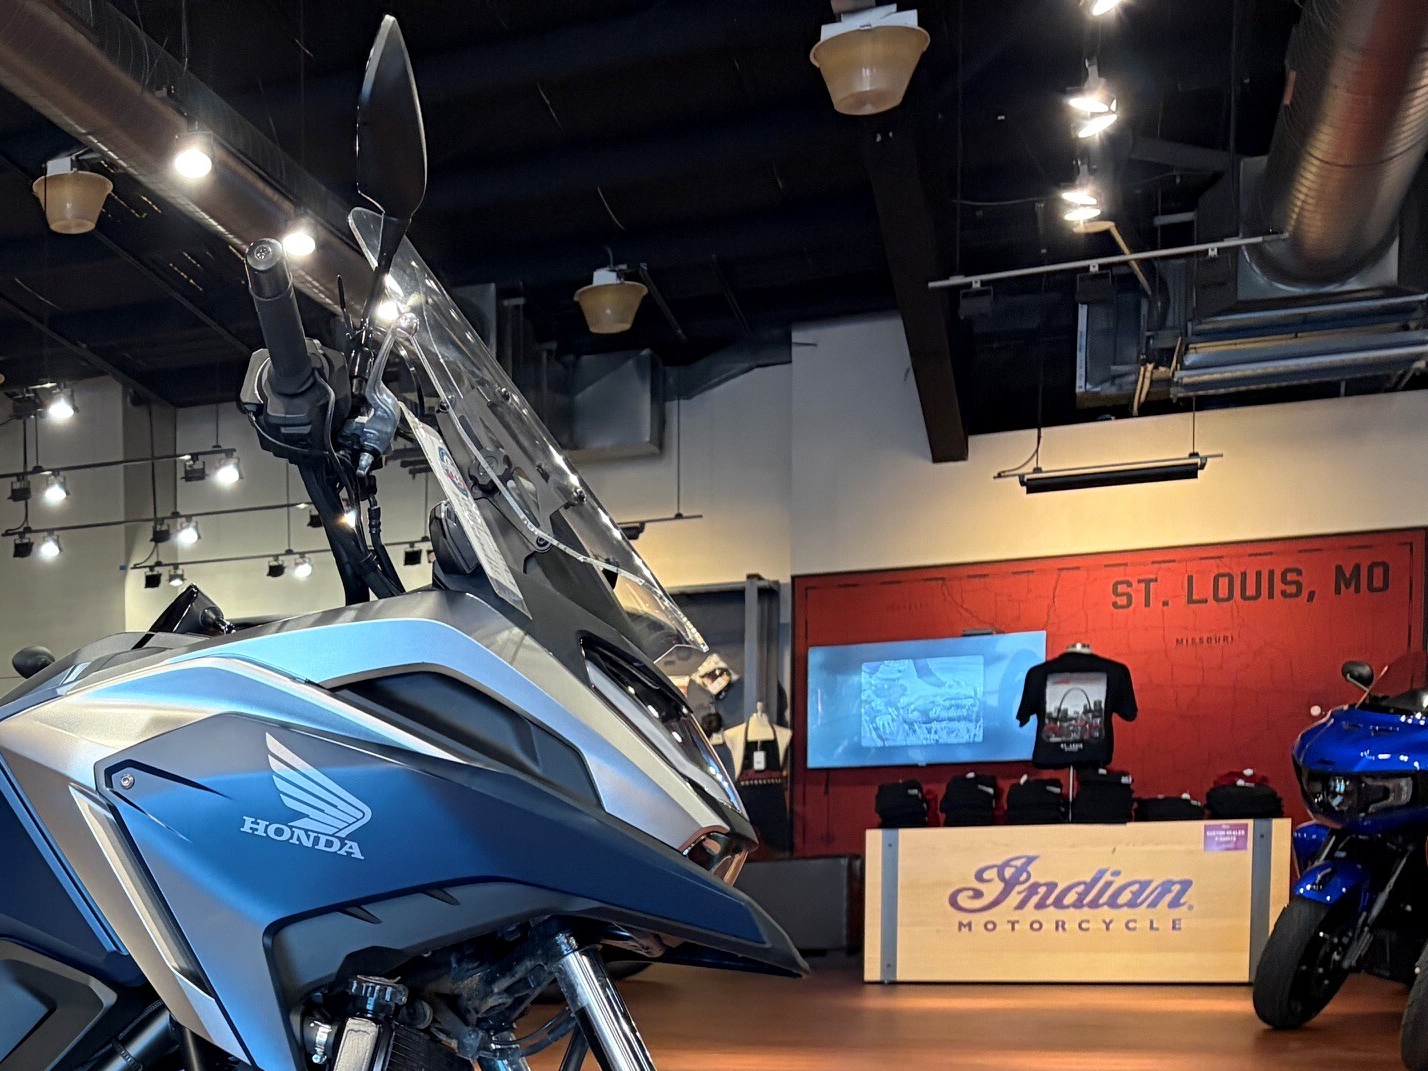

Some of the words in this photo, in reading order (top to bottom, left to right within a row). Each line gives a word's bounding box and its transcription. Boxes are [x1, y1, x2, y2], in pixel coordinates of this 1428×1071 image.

[1111, 576, 1169, 610] ST.
[1186, 567, 1316, 604] LOUIS,
[1334, 560, 1390, 596] MO
[1175, 634, 1234, 646] MISSOURI
[240, 815, 365, 860] HONDA
[948, 854, 1194, 914] Indian
[957, 918, 1183, 932] MOTORCYCLE
